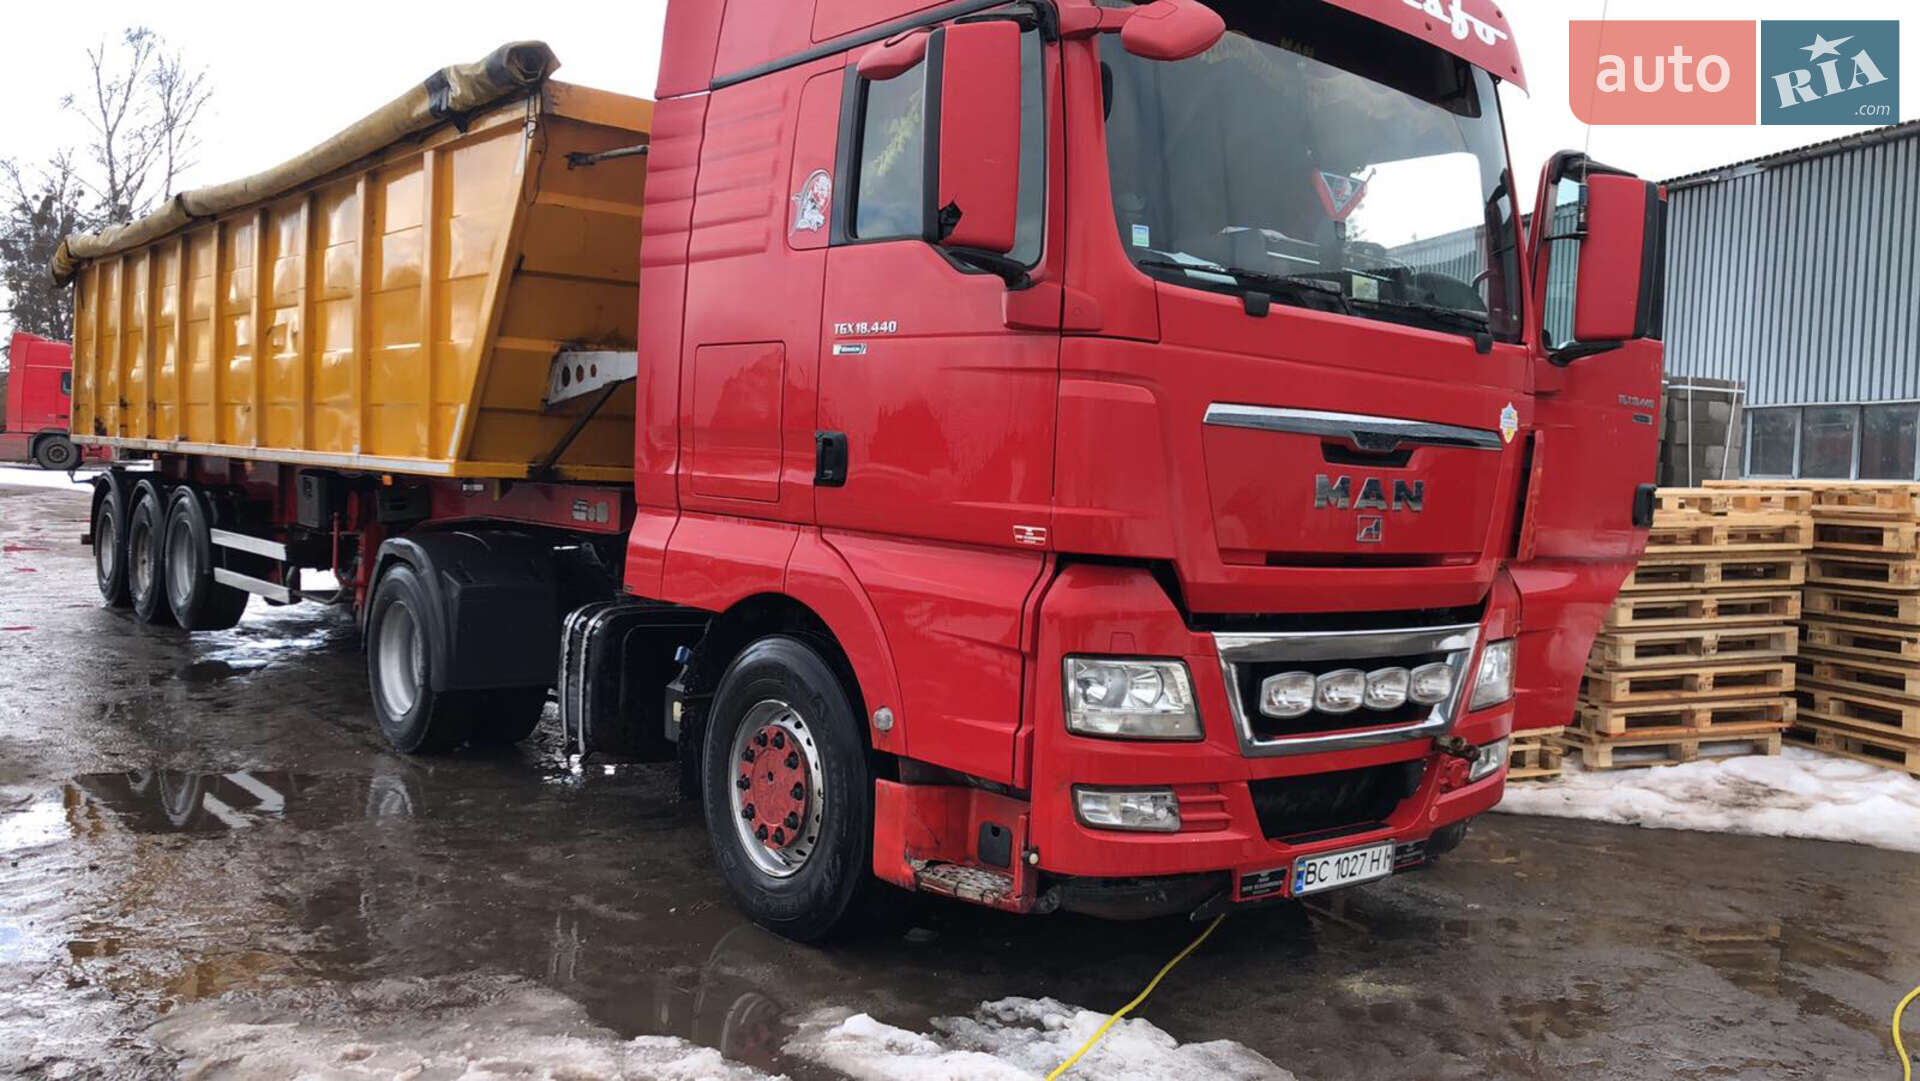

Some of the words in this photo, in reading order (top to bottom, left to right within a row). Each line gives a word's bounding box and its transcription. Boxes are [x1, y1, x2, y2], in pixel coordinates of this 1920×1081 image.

[1314, 474, 1424, 511] MAN
[1305, 860, 1330, 886] BC
[1335, 853, 1367, 880] 1027
